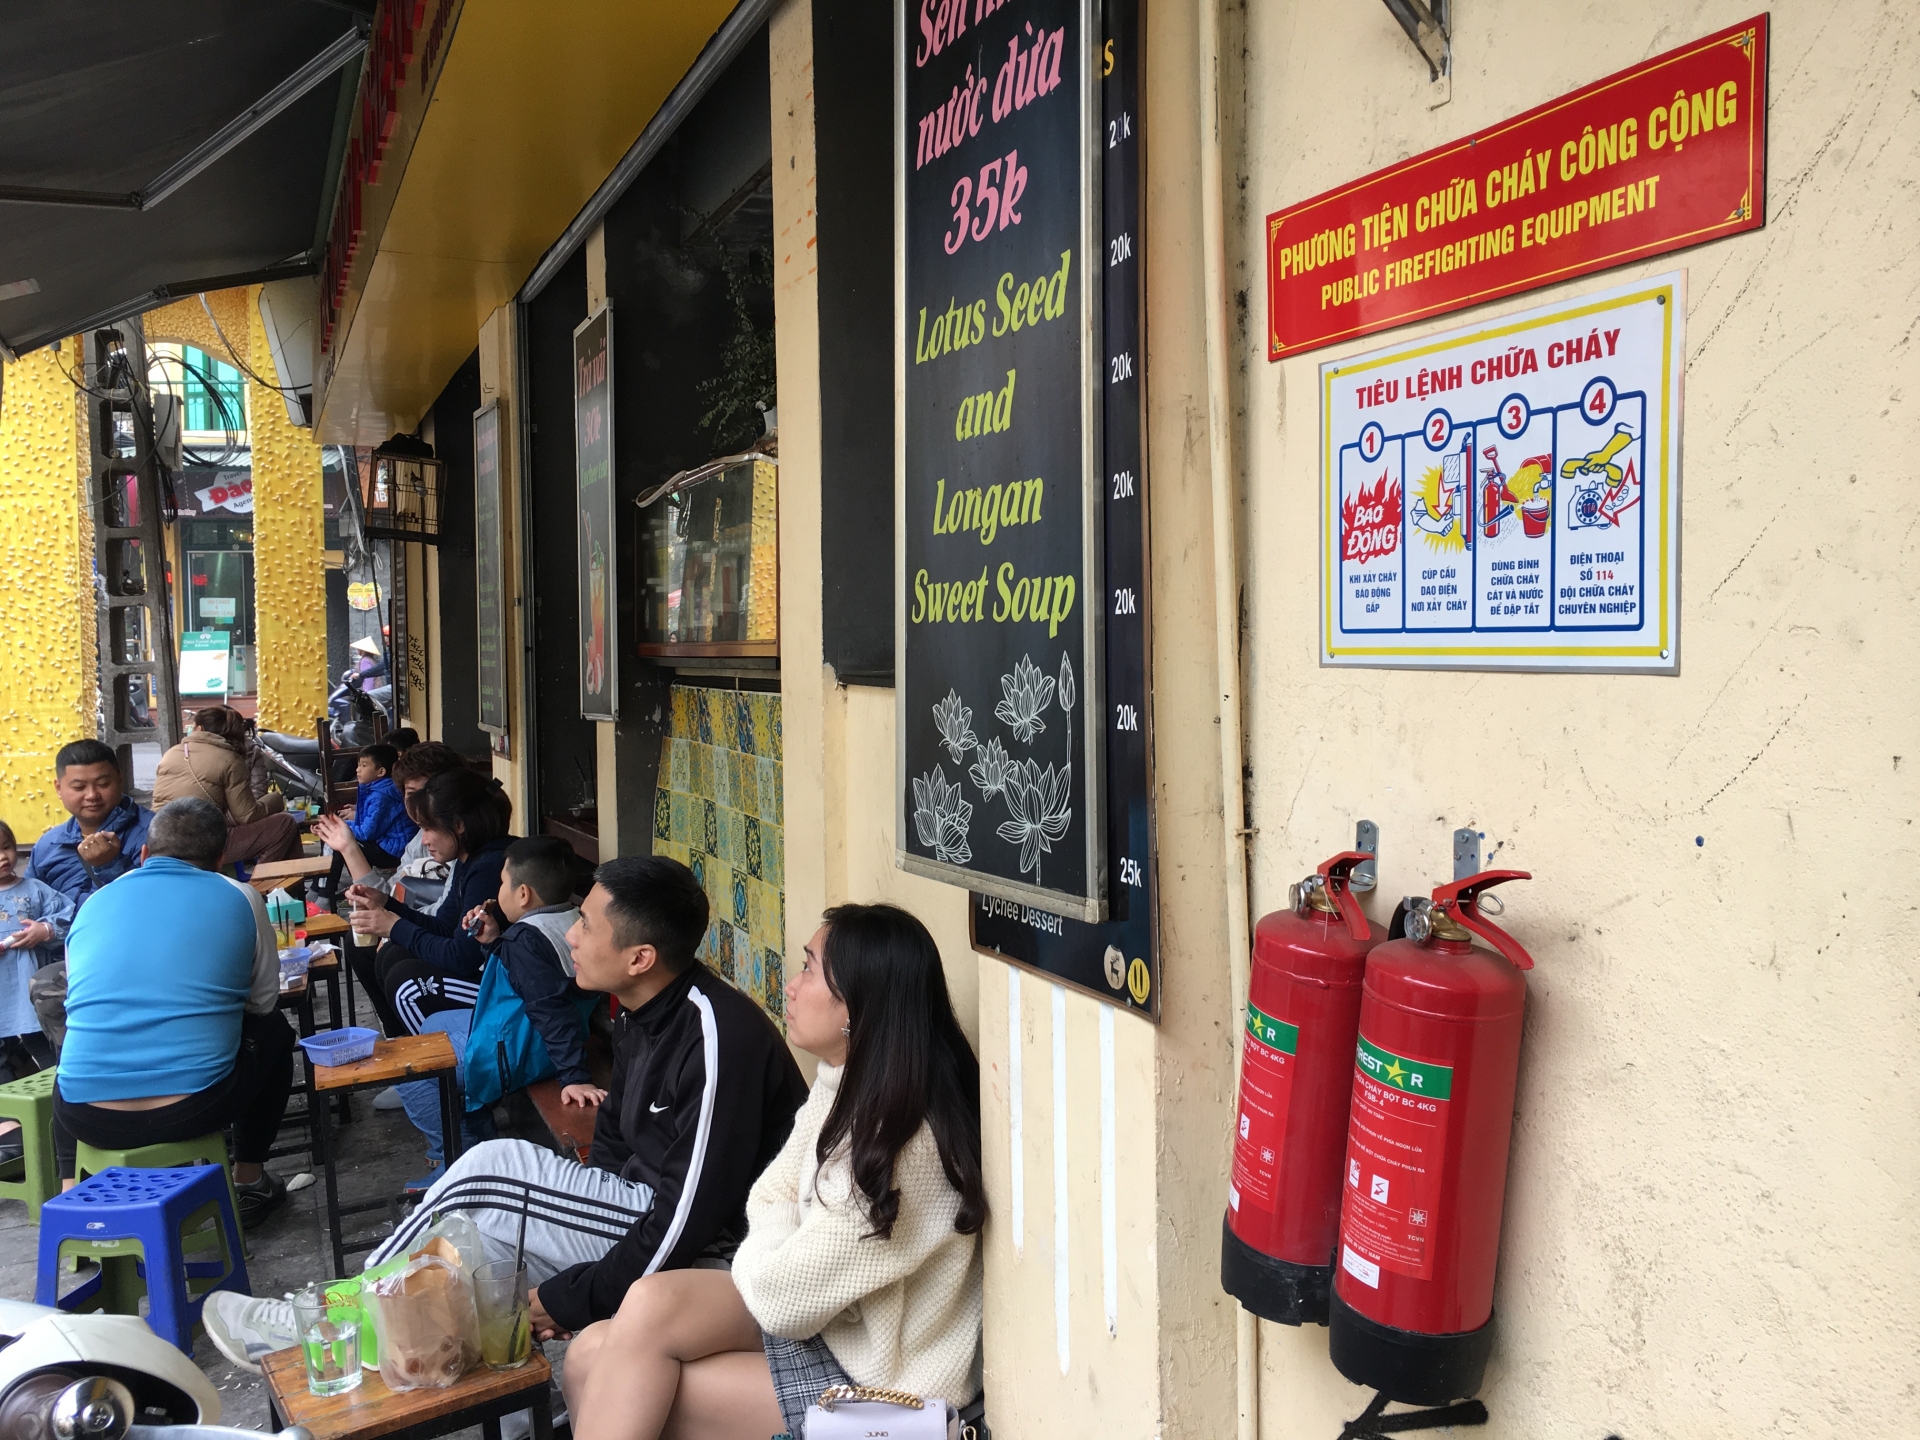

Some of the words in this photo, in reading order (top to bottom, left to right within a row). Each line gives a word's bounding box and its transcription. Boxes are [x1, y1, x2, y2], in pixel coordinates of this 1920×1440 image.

[917, 63, 988, 171] nước
[992, 20, 1065, 124] dừa
[1280, 223, 1356, 280] PHƯƠNG
[1362, 202, 1408, 252] TIỆN
[1415, 177, 1478, 232] CHỮA
[1486, 148, 1552, 208] CHÁY
[1560, 117, 1638, 182] CÔNG
[1648, 80, 1738, 152] CỘNG
[944, 148, 1028, 255] 35k
[1110, 232, 1132, 267] 20k
[1321, 268, 1380, 311] PUBLIC
[1385, 224, 1515, 291] FIREFIGHTING
[1522, 175, 1660, 248] EQUIPMENT
[916, 296, 987, 365] Lotus
[992, 249, 1071, 338] Seed
[1111, 352, 1133, 384] 20k
[1356, 378, 1398, 409] TIÊU
[1405, 364, 1463, 402] LỆNH
[1471, 346, 1539, 385] CHỮA
[1547, 328, 1622, 369] CHÁY
[955, 368, 1016, 442] and
[1589, 388, 1607, 414] 4
[585, 405, 602, 448] 30k
[1431, 418, 1445, 442] 2
[1507, 405, 1522, 430] 3
[1365, 431, 1375, 453] 1
[1113, 470, 1134, 500] 20k
[233, 497, 254, 510] Agen
[933, 477, 1044, 546] Longan
[1353, 501, 1385, 528] BÁO
[1346, 524, 1396, 561] ĐỘNG
[1491, 559, 1516, 571] DÙNG
[1518, 558, 1540, 570] BÌNH
[1570, 551, 1593, 567] ĐIỆN
[1595, 551, 1625, 566] THOẠI
[1349, 574, 1361, 584] KHI
[1378, 570, 1398, 583] CHÁY
[1422, 567, 1438, 580] CÚP
[1516, 573, 1540, 585] CHÁY
[1580, 566, 1593, 581] SỐ
[1596, 569, 1614, 581] 114
[911, 564, 989, 624] Sweet
[992, 561, 1076, 639] Soup
[1114, 587, 1136, 615] 20k
[1355, 587, 1370, 599] BÁO
[1371, 586, 1391, 600] ĐỘNG
[1421, 585, 1437, 596] DAO
[1438, 583, 1458, 597] ĐIỆN
[1487, 589, 1503, 601] CÁT
[1505, 588, 1517, 600] VÀ
[1560, 586, 1576, 601] ĐỘI
[1608, 583, 1635, 597] CHÁY
[1446, 598, 1468, 611] CHÁY
[1504, 603, 1521, 617] DẬP
[1558, 601, 1597, 615] CHUYÊN
[1599, 600, 1637, 616] NGHIỆP
[1116, 704, 1138, 732] 20k
[1120, 857, 1142, 888] 25k
[981, 894, 1019, 921] Lychee
[1021, 905, 1063, 937] Dessert
[1402, 1098, 1415, 1108] BC
[1416, 1102, 1437, 1113] 4KG
